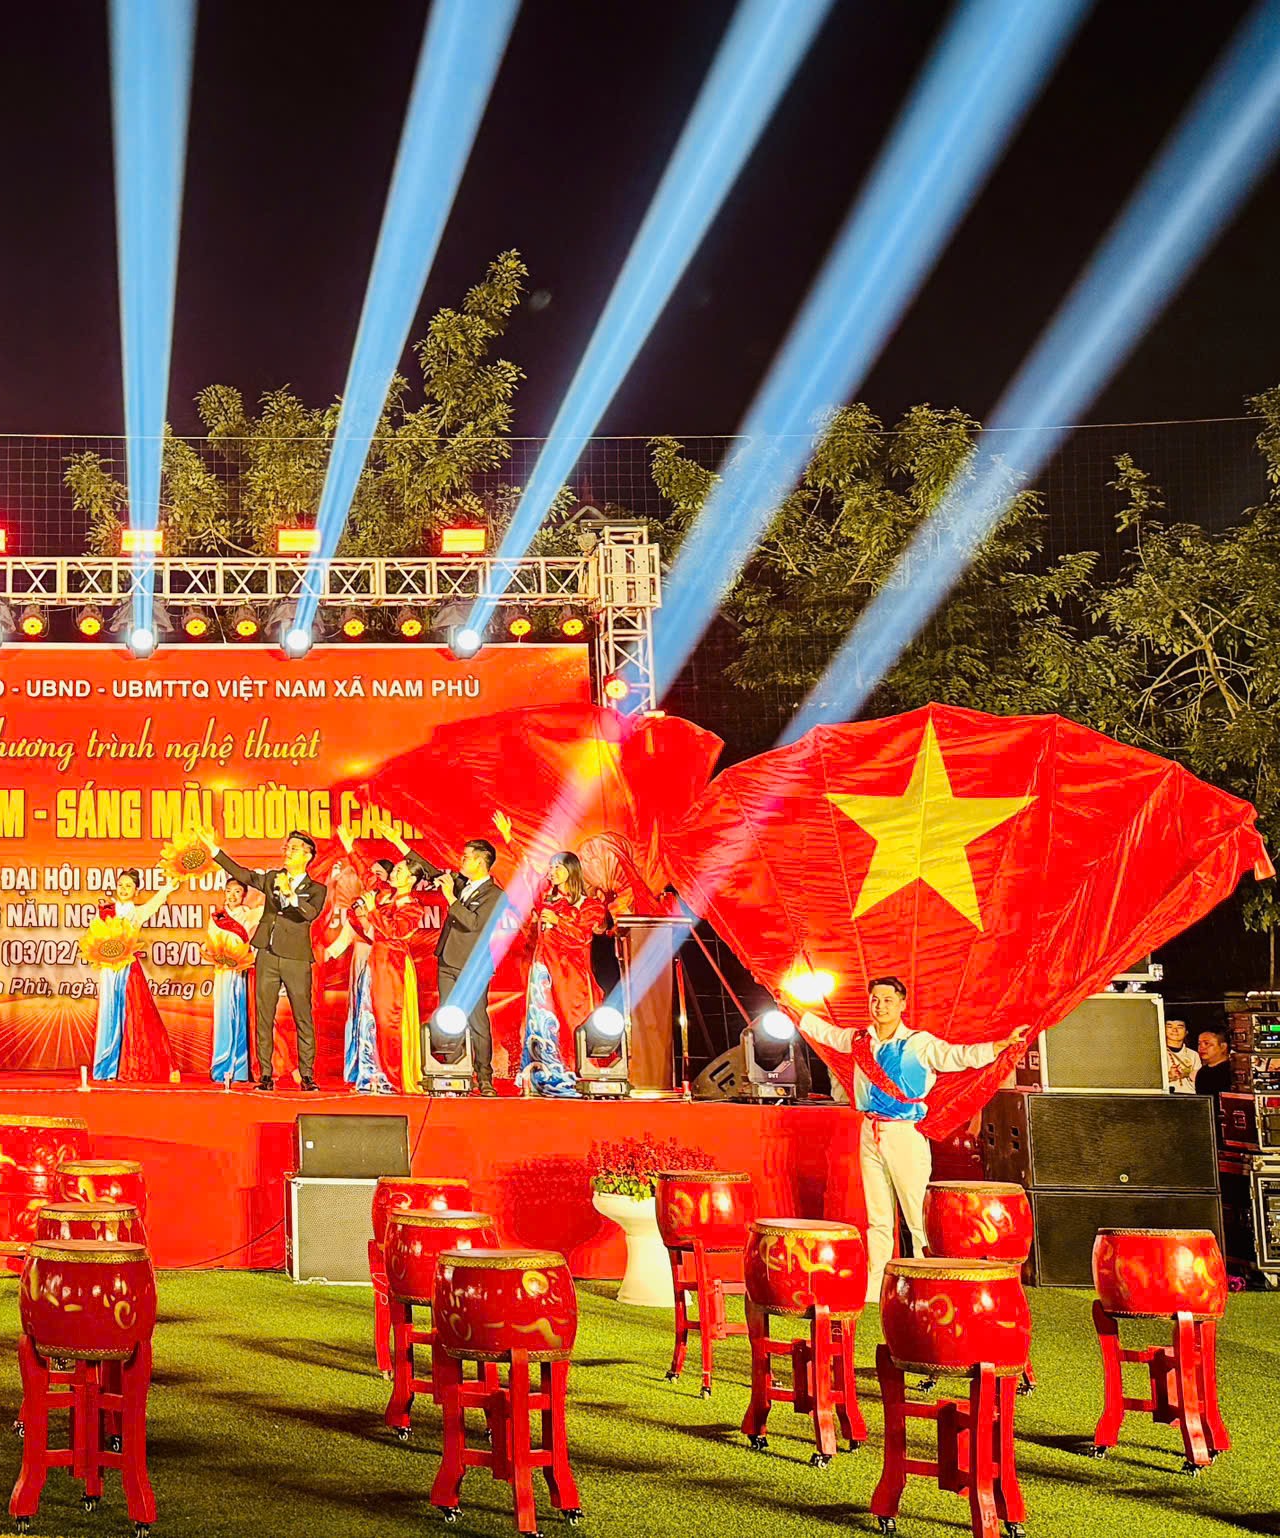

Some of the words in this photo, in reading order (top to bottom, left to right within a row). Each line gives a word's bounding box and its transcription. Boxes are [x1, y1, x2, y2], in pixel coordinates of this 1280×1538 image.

[26, 679, 91, 698] UBND
[112, 679, 209, 699] UBMTTQ
[216, 676, 268, 702] VIỆT
[275, 679, 327, 698] NAM
[333, 675, 365, 698] XÃ
[372, 679, 423, 698] NAM
[431, 675, 481, 698] PHÙ
[86, 717, 155, 759] trình
[165, 717, 234, 772] nghệ
[243, 717, 321, 766] thuật
[56, 780, 142, 839] SÁNG
[151, 781, 212, 839] MÃI
[223, 781, 331, 839] ĐƯỜNG
[1, 867, 38, 896] ĐẠI
[44, 862, 80, 896] HỘI
[86, 867, 123, 896] ĐẠ
[7, 898, 59, 928] NĂM
[9, 977, 52, 997] Phù,
[147, 979, 195, 1000] háng
